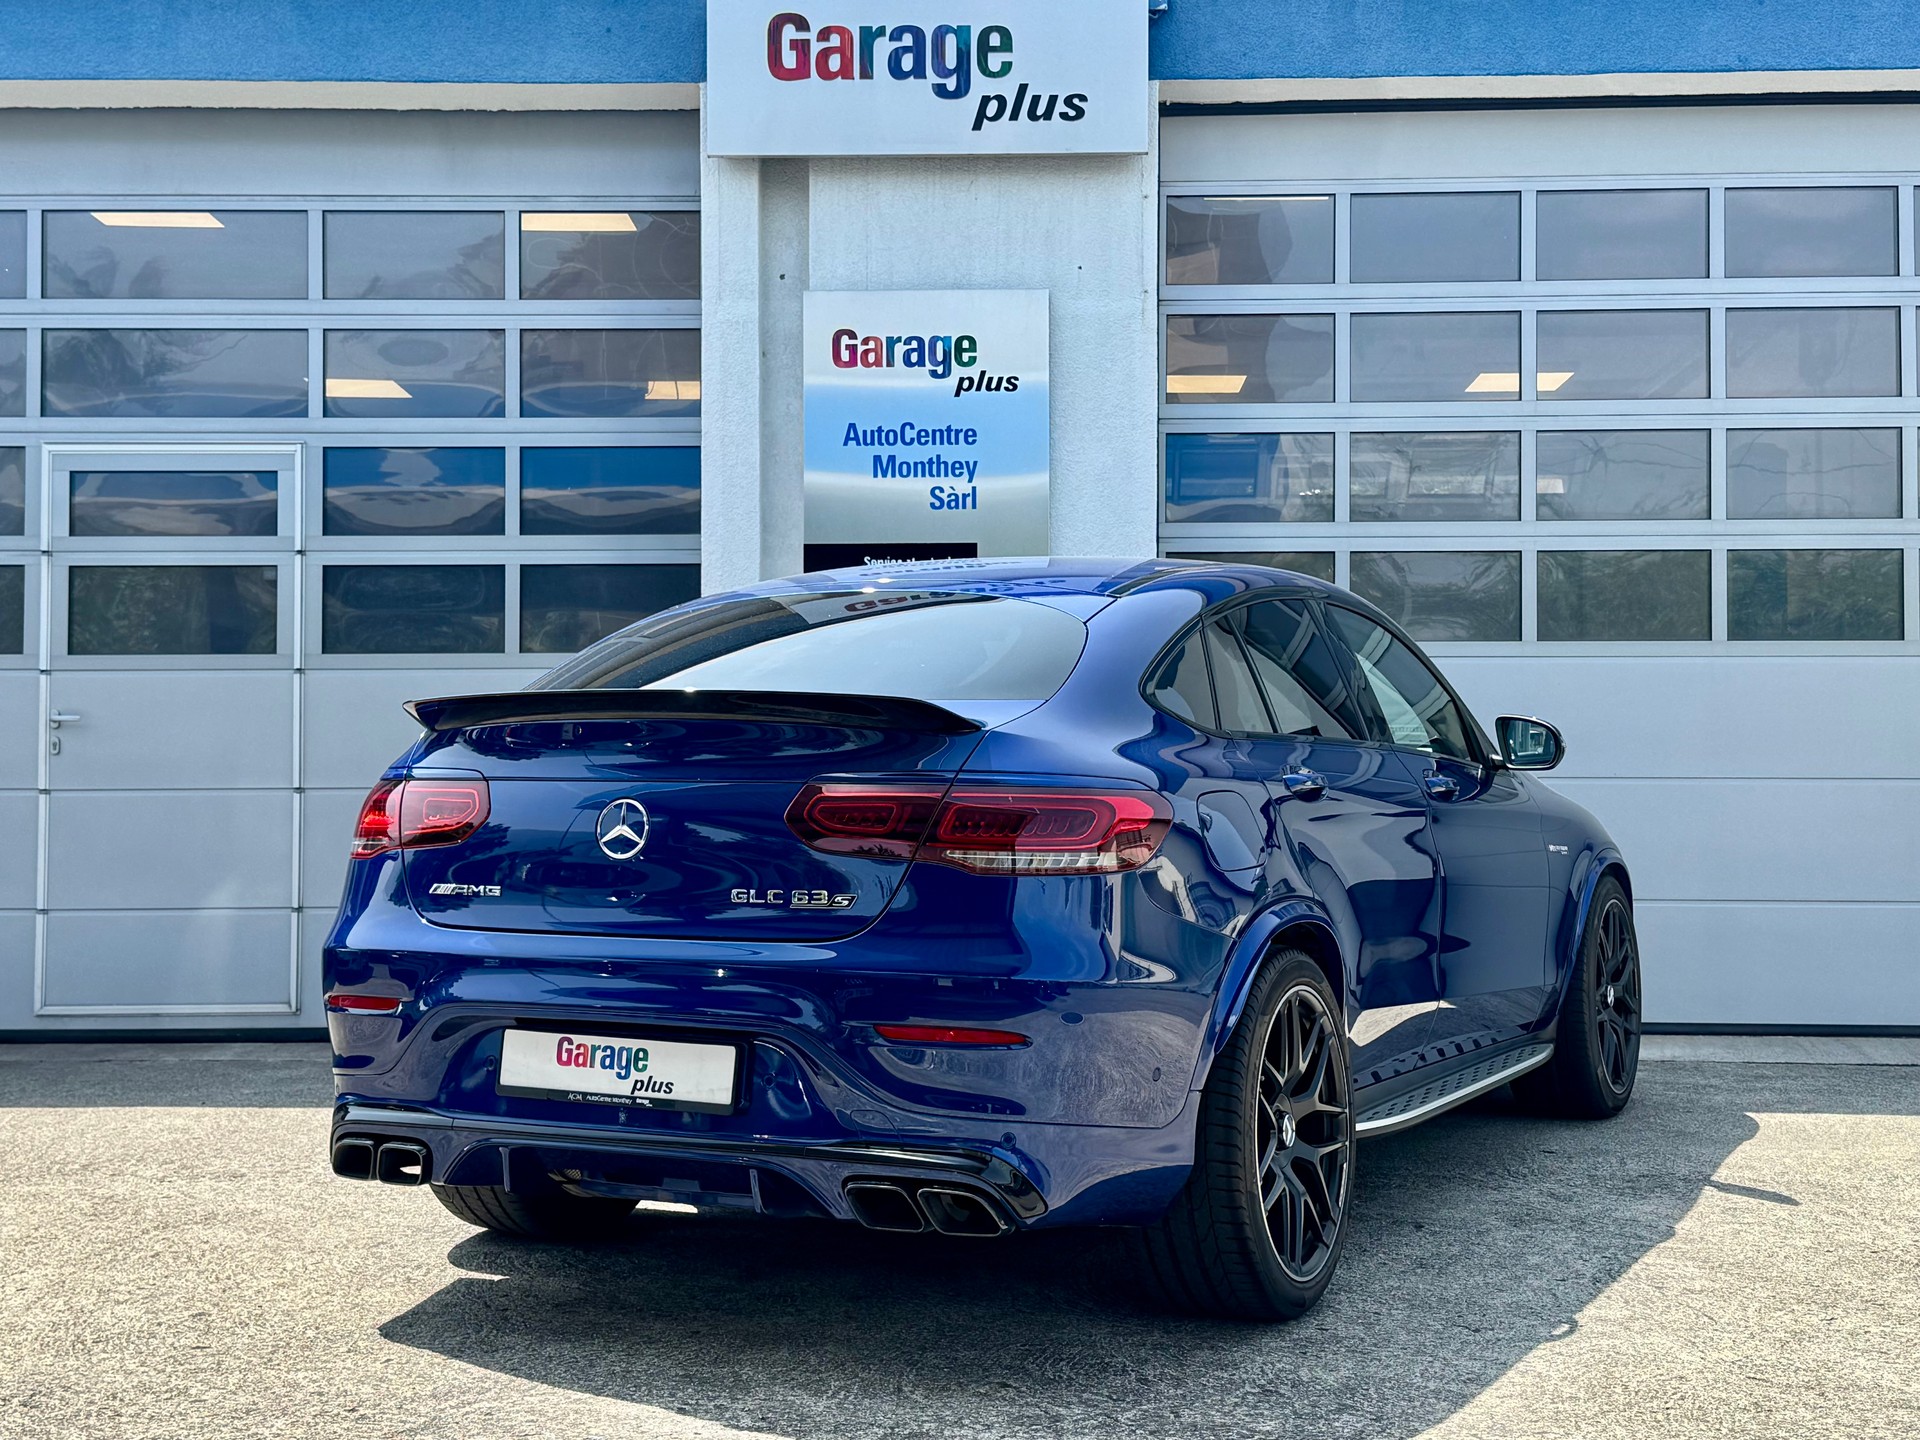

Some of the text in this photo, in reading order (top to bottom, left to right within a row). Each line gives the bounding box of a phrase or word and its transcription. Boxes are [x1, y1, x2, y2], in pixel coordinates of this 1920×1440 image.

[767, 12, 1014, 100] Garage
[971, 83, 1088, 131] plus
[832, 328, 978, 379] Garage
[954, 370, 1019, 397] plus
[843, 421, 978, 447] AutoCentre
[872, 454, 978, 483] Monthey
[929, 486, 977, 510] Sàrl
[730, 888, 784, 904] GLC
[556, 1036, 649, 1080] Garage
[631, 1075, 675, 1095] plus
